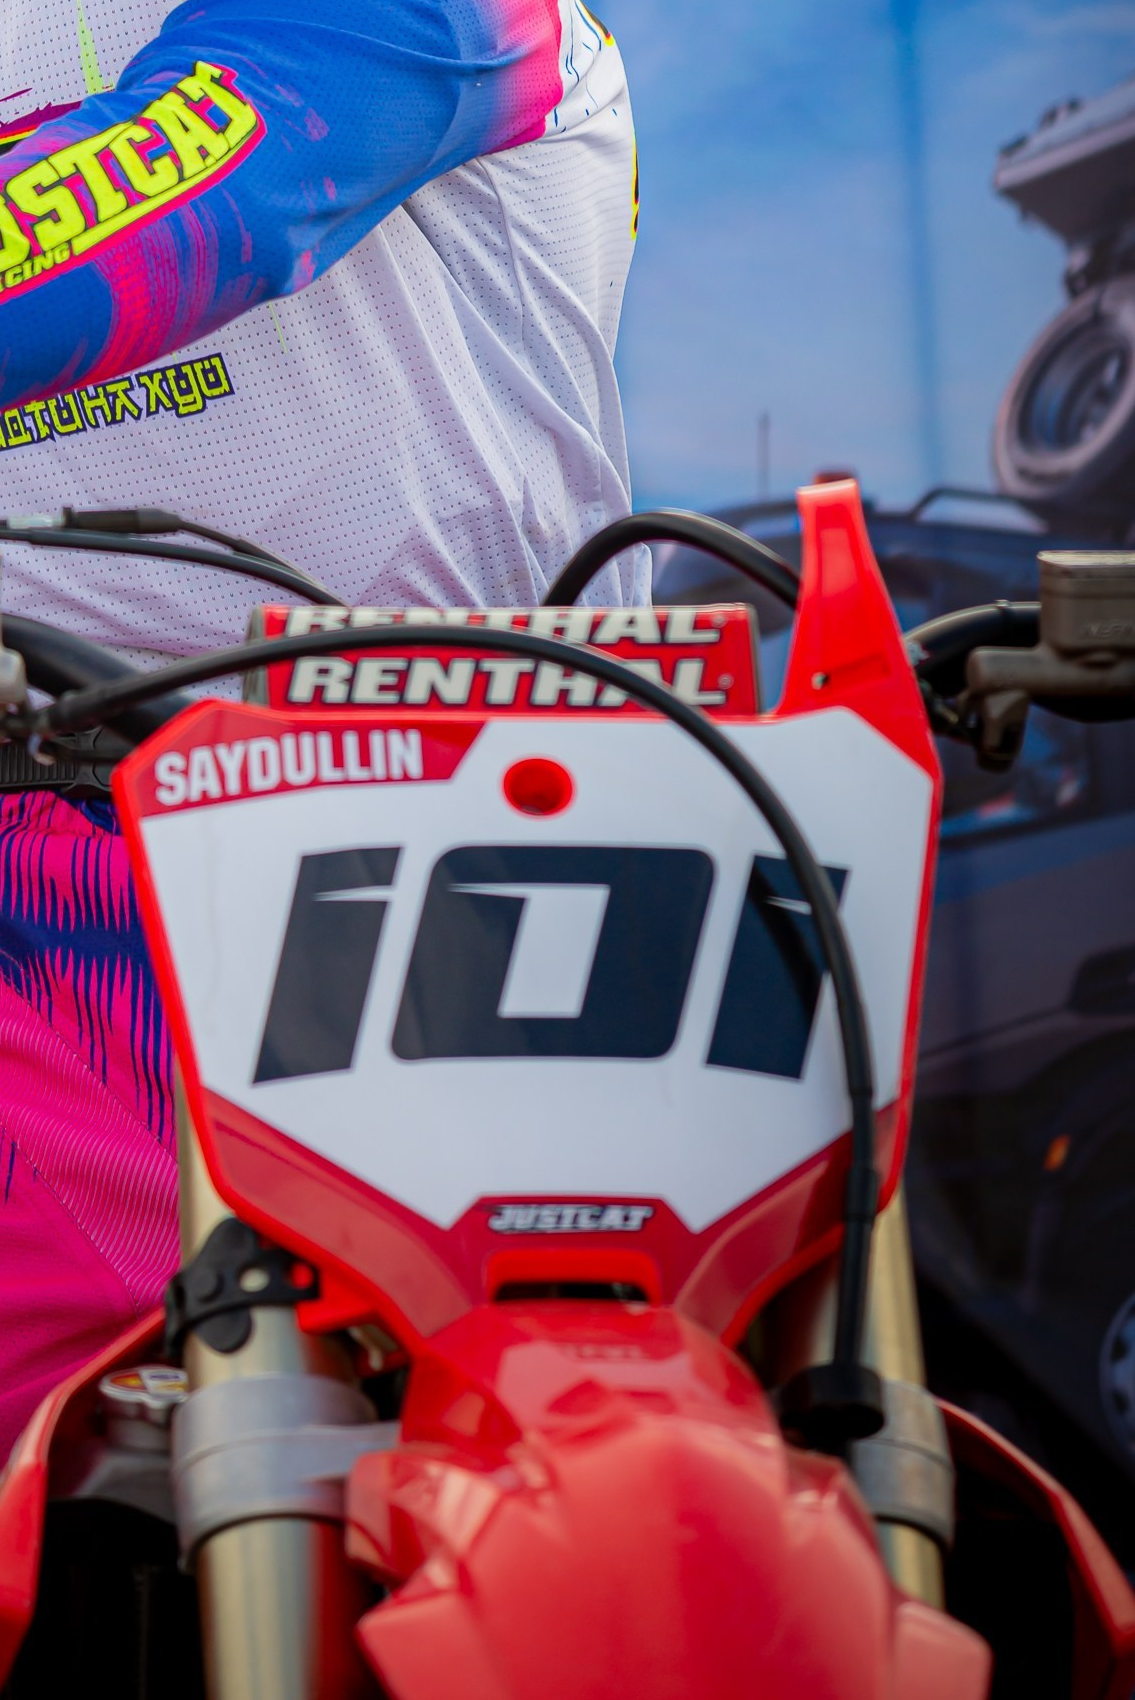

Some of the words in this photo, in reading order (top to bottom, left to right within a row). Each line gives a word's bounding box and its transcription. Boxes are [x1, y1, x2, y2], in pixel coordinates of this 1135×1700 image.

[154, 728, 424, 807] SAYDULLIN
[252, 845, 851, 1086] 101
[487, 1202, 654, 1234] JUSTCAT
